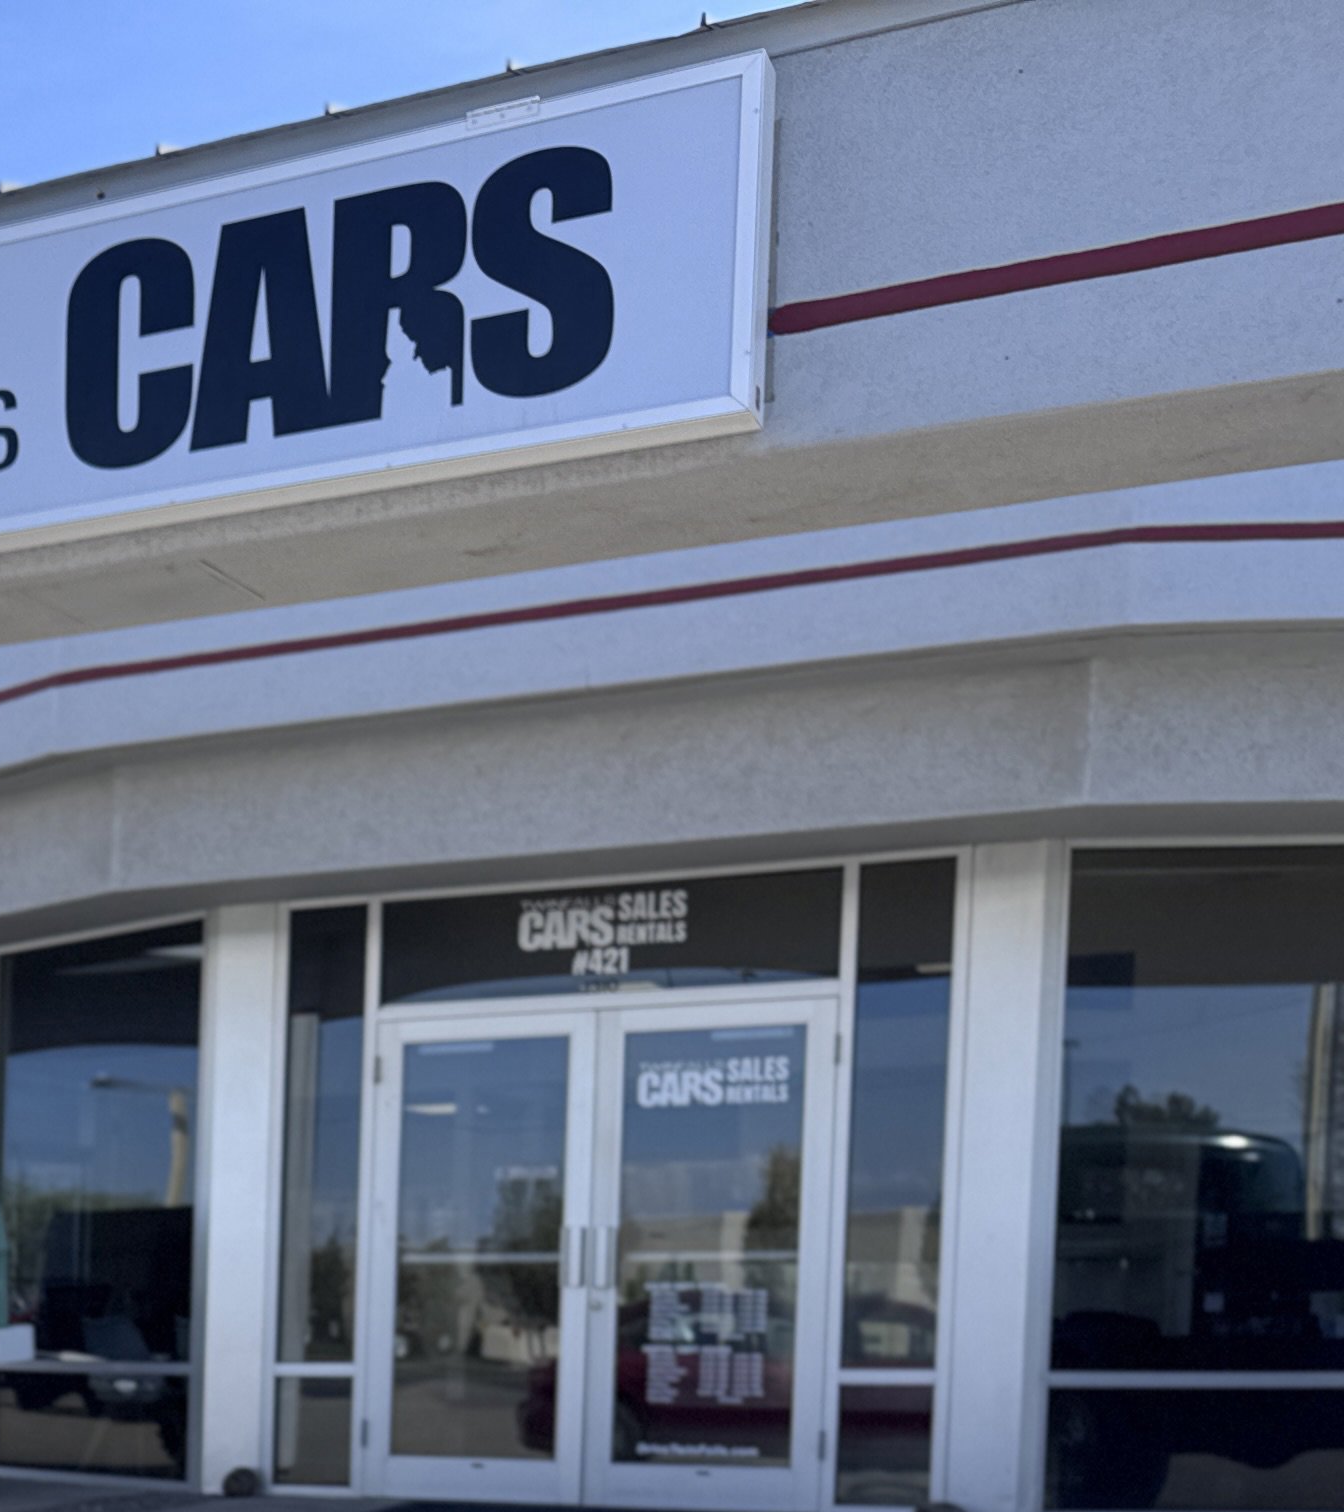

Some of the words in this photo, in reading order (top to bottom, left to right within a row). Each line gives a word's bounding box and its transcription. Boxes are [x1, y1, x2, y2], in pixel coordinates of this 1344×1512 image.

[65, 145, 615, 470] CARS
[519, 907, 614, 951] CARS
[618, 889, 688, 921] SALES
[617, 921, 687, 944] RENTALS
[572, 947, 630, 976] #421
[638, 1068, 724, 1108] CARS
[726, 1056, 790, 1082] SALES
[726, 1083, 789, 1104] RENTALS
